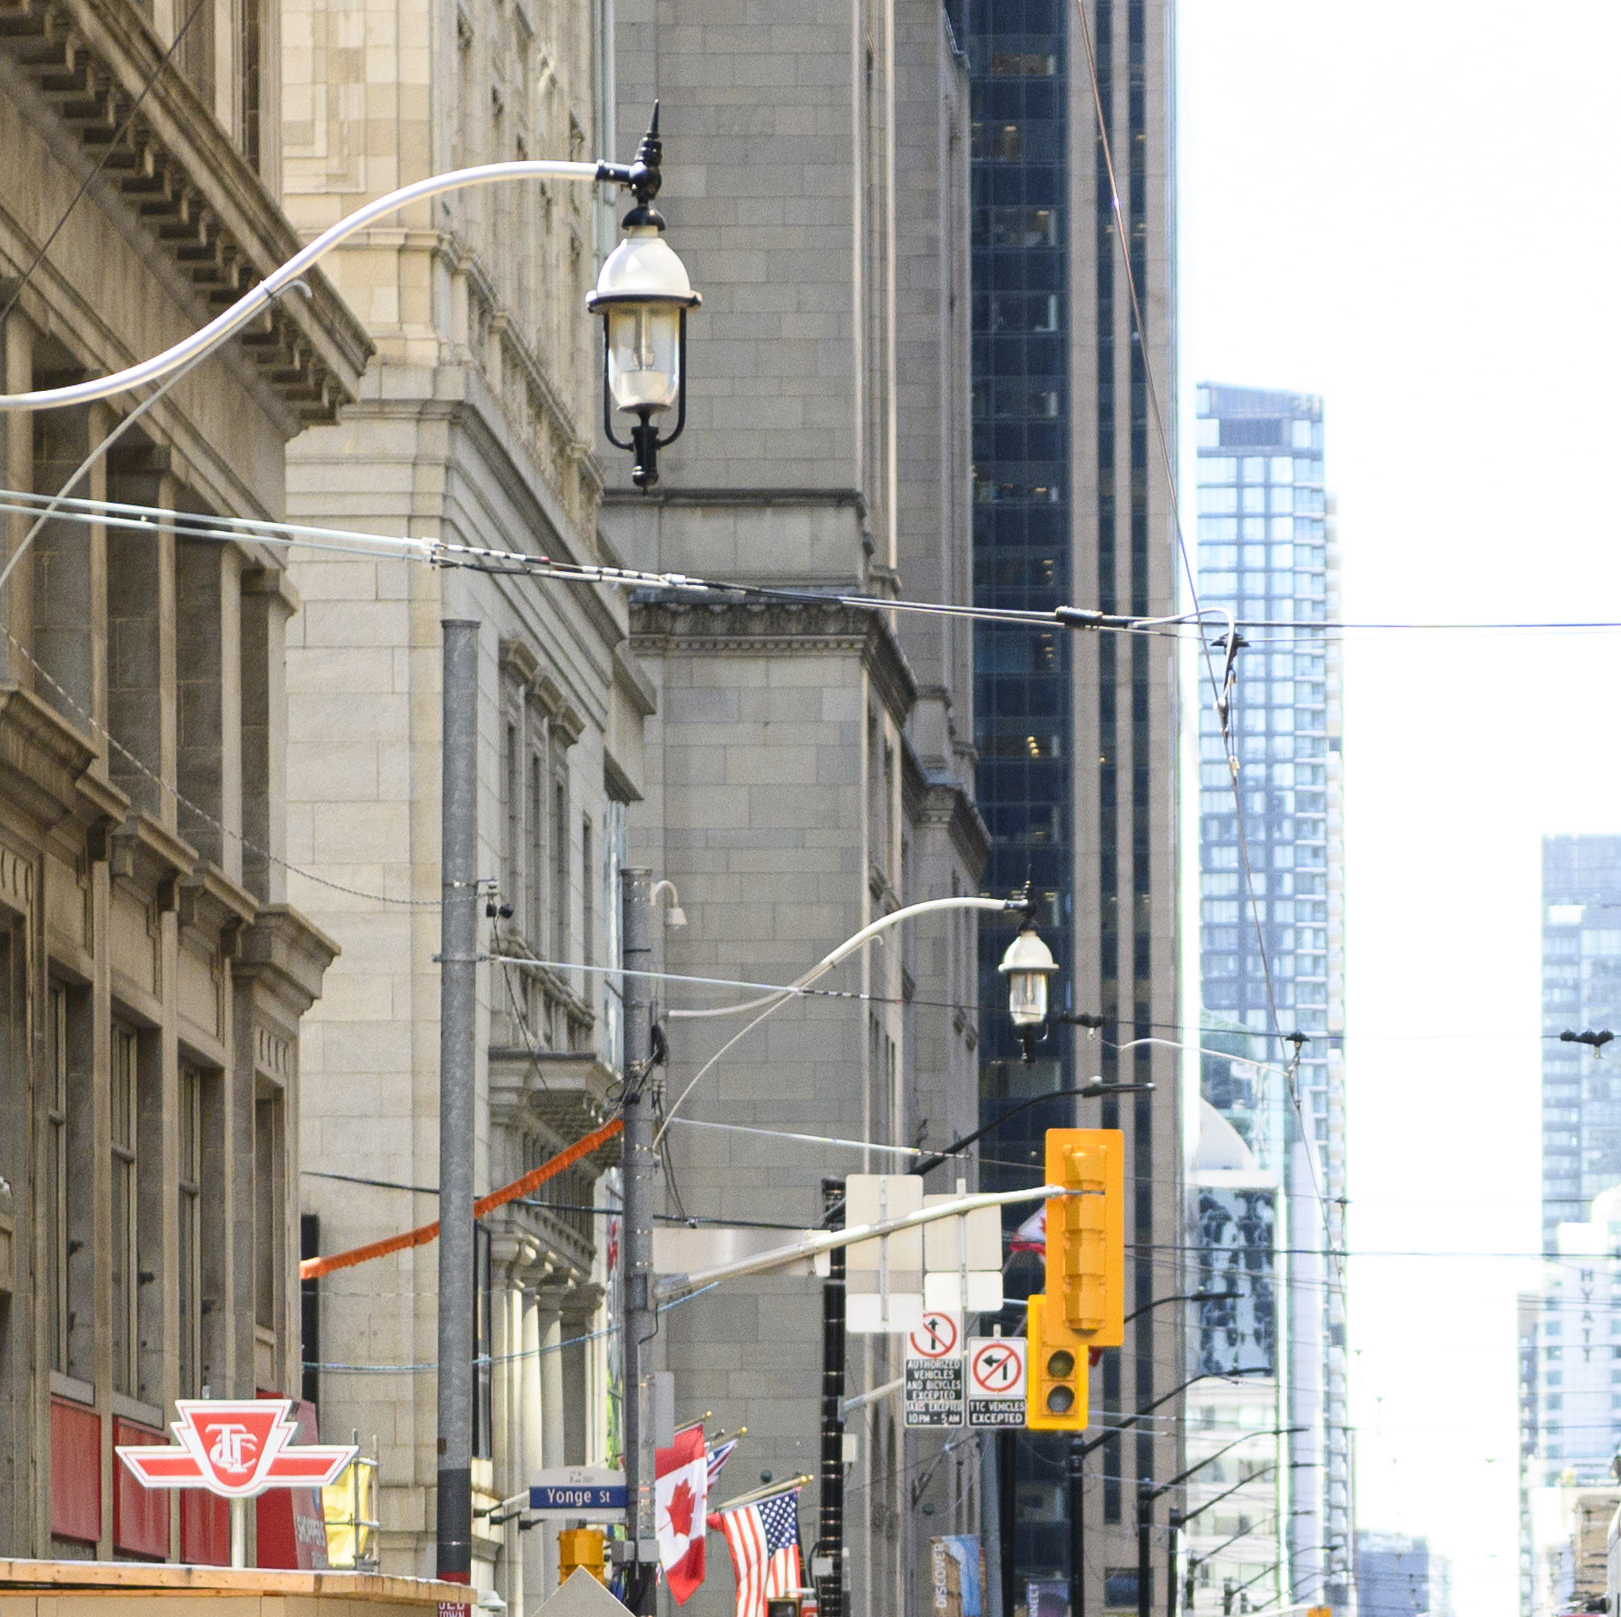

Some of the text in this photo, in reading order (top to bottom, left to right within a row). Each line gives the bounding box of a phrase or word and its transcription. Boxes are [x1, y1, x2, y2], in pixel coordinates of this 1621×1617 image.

[1580, 1268, 1595, 1363] HYATT
[907, 1359, 961, 1369] AUTHORIZED
[913, 1369, 955, 1380] VEHICLES
[906, 1380, 961, 1390] AND BICYCLES
[912, 1390, 956, 1400] EXCEPTED
[970, 1401, 1025, 1412] TTC VEHICLES
[972, 1412, 1023, 1423] EXCEPTED
[547, 1487, 611, 1507] Yonge St
[933, 1542, 948, 1609] DISCOVER
